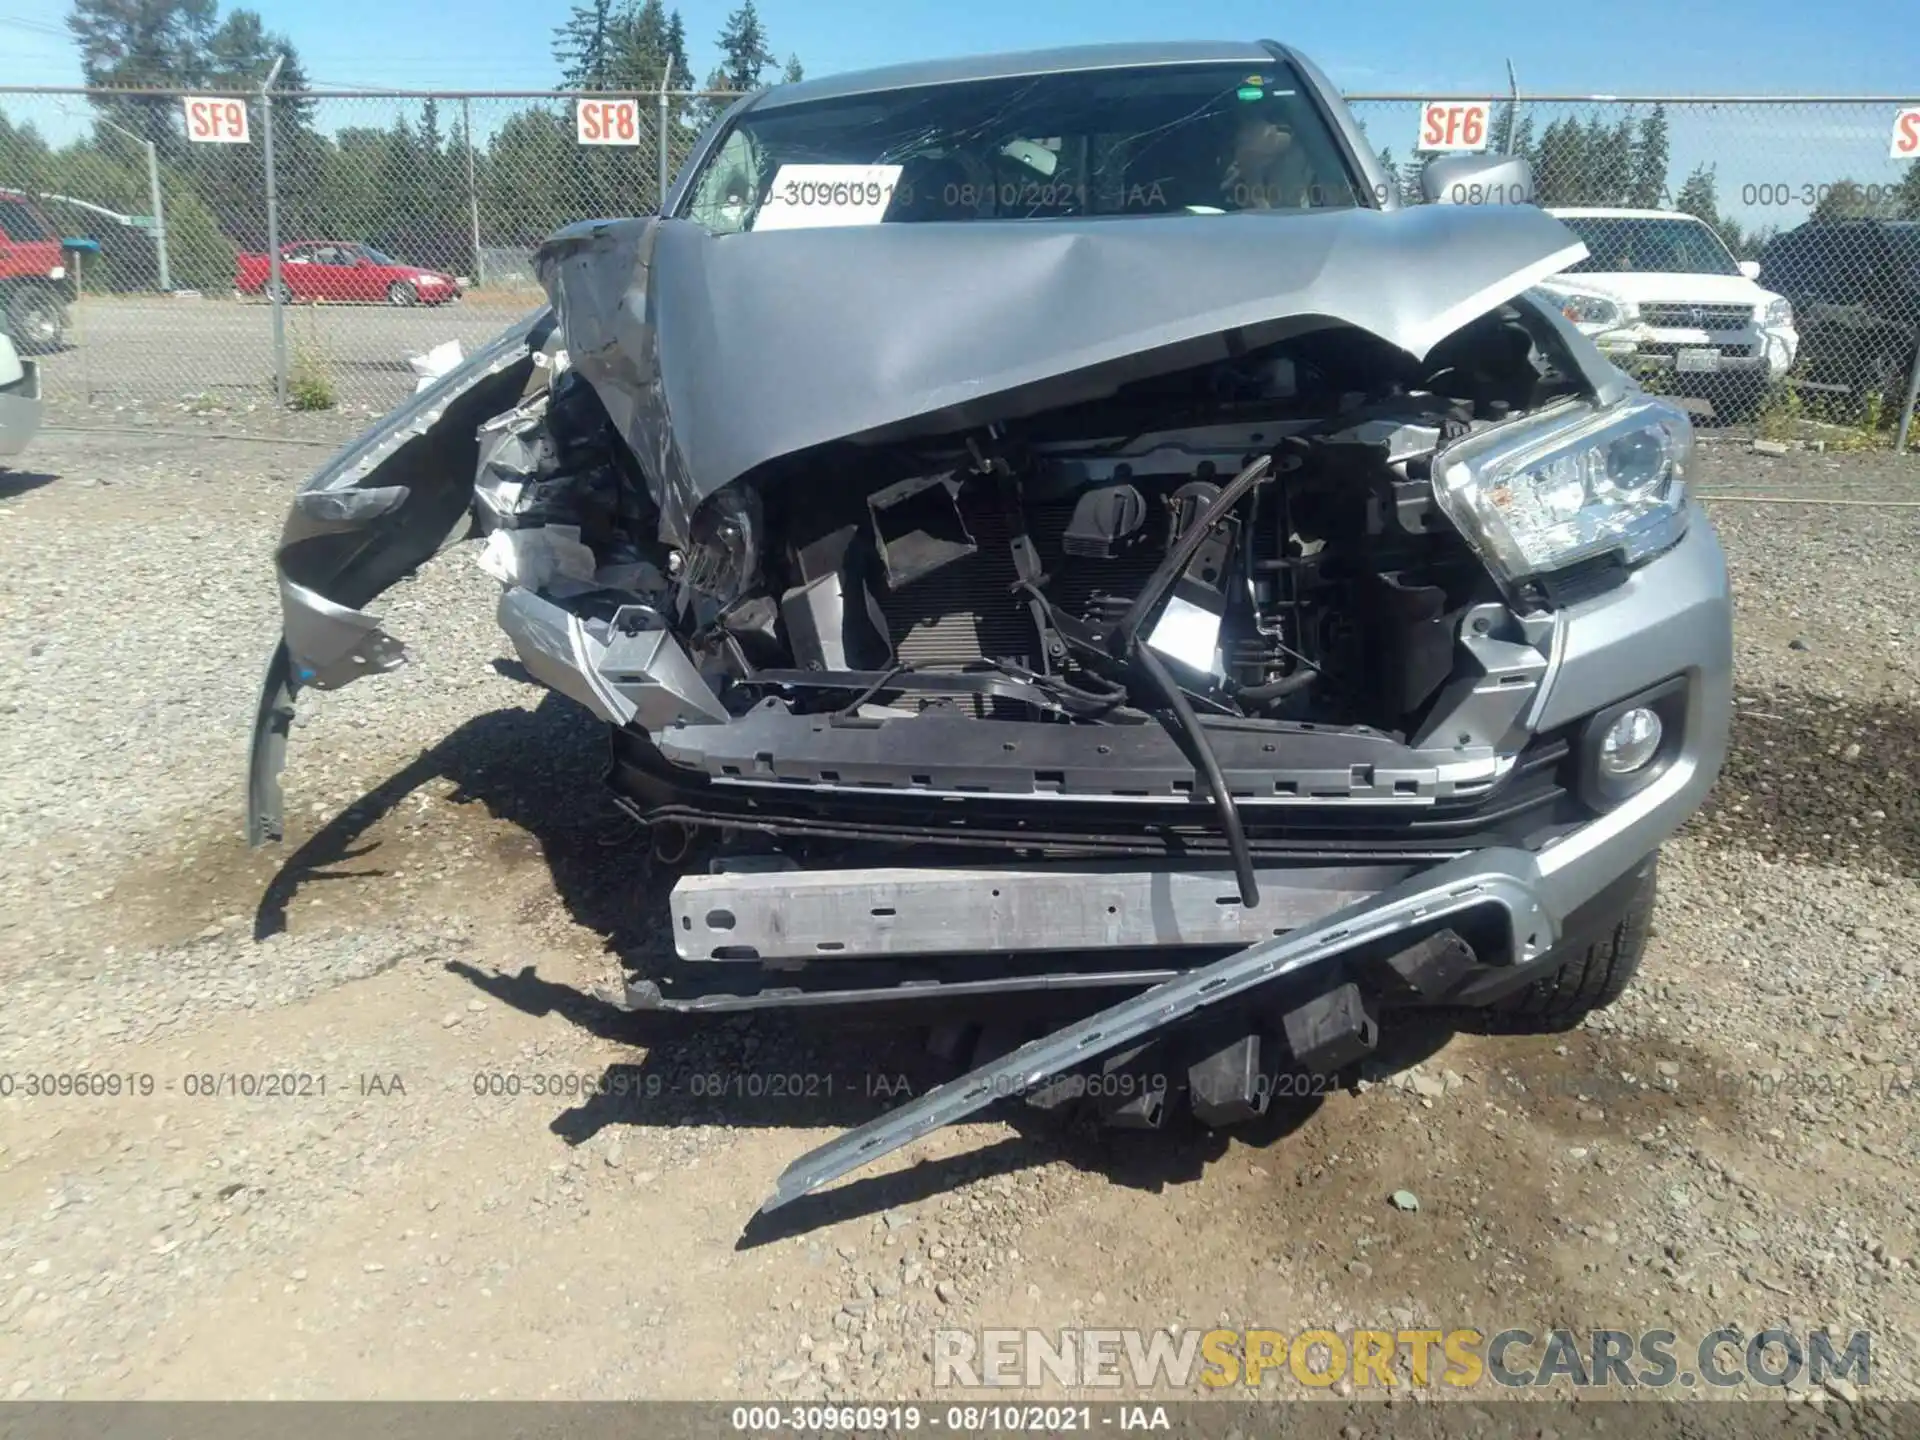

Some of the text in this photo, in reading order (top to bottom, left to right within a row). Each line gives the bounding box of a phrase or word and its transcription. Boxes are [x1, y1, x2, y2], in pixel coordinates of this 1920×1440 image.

[191, 102, 243, 137] SF9
[582, 103, 634, 139] SF8
[1424, 106, 1484, 145] SF6
